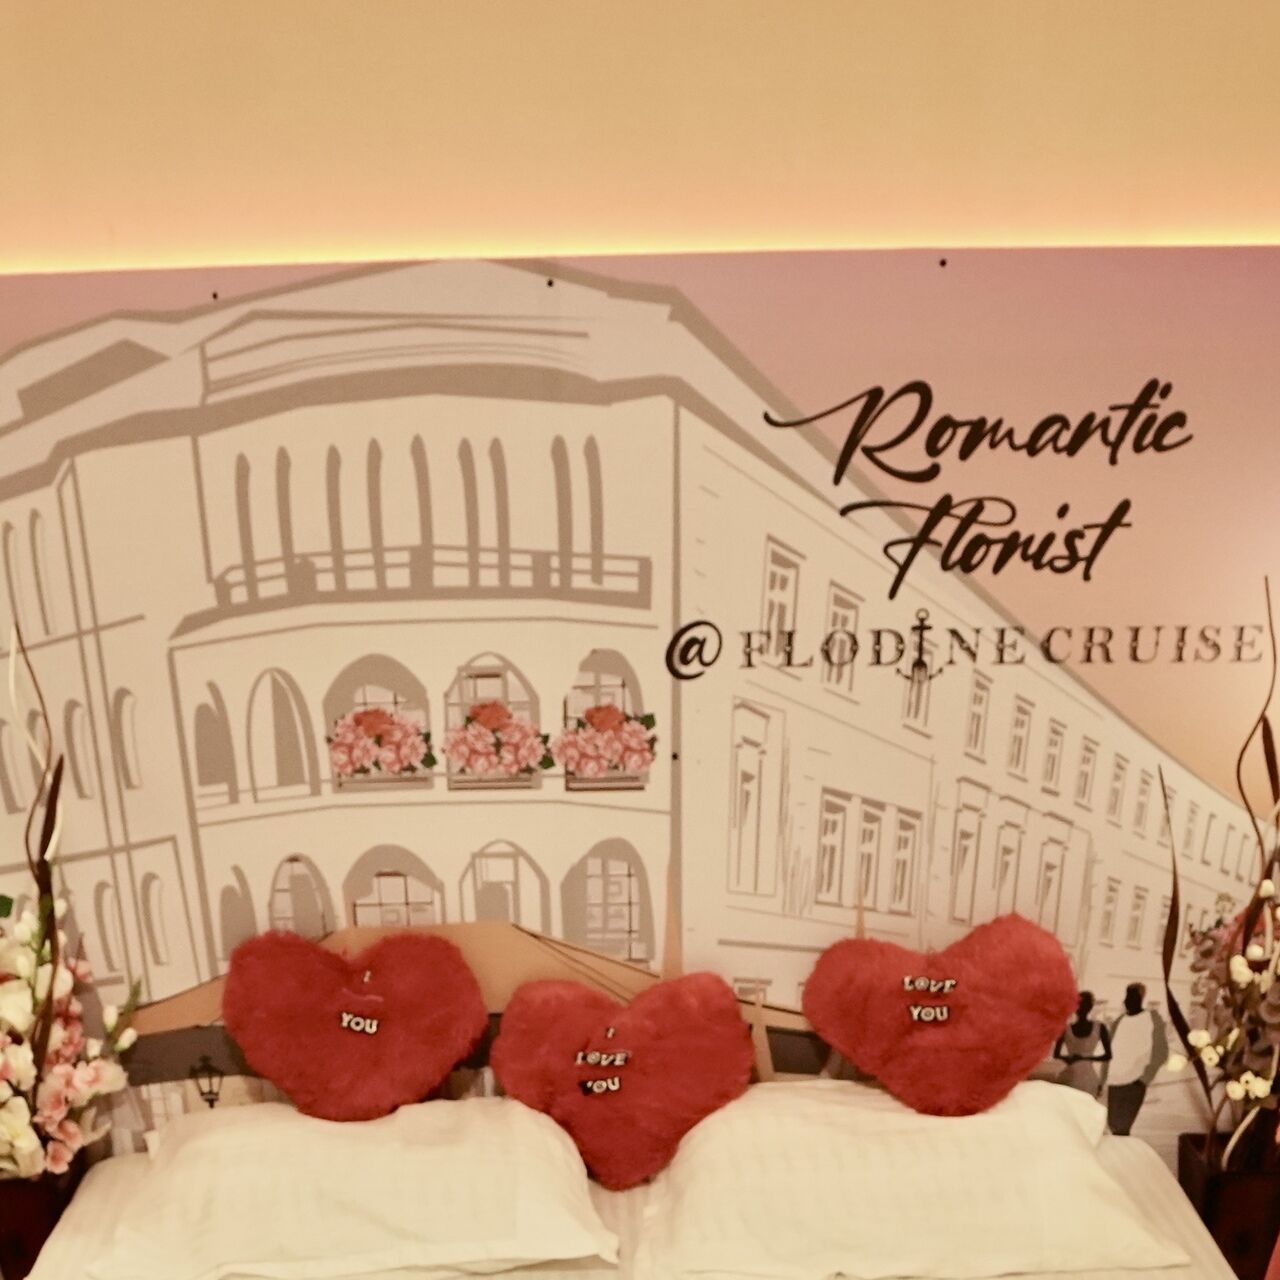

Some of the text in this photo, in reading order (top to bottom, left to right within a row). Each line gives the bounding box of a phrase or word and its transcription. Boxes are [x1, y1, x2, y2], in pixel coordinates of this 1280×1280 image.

[763, 378, 1193, 486] Romantic
[839, 494, 1132, 600] Florist
[341, 1011, 378, 1034] YOU
[909, 1005, 948, 1022] YOU
[582, 1076, 620, 1094] OU
